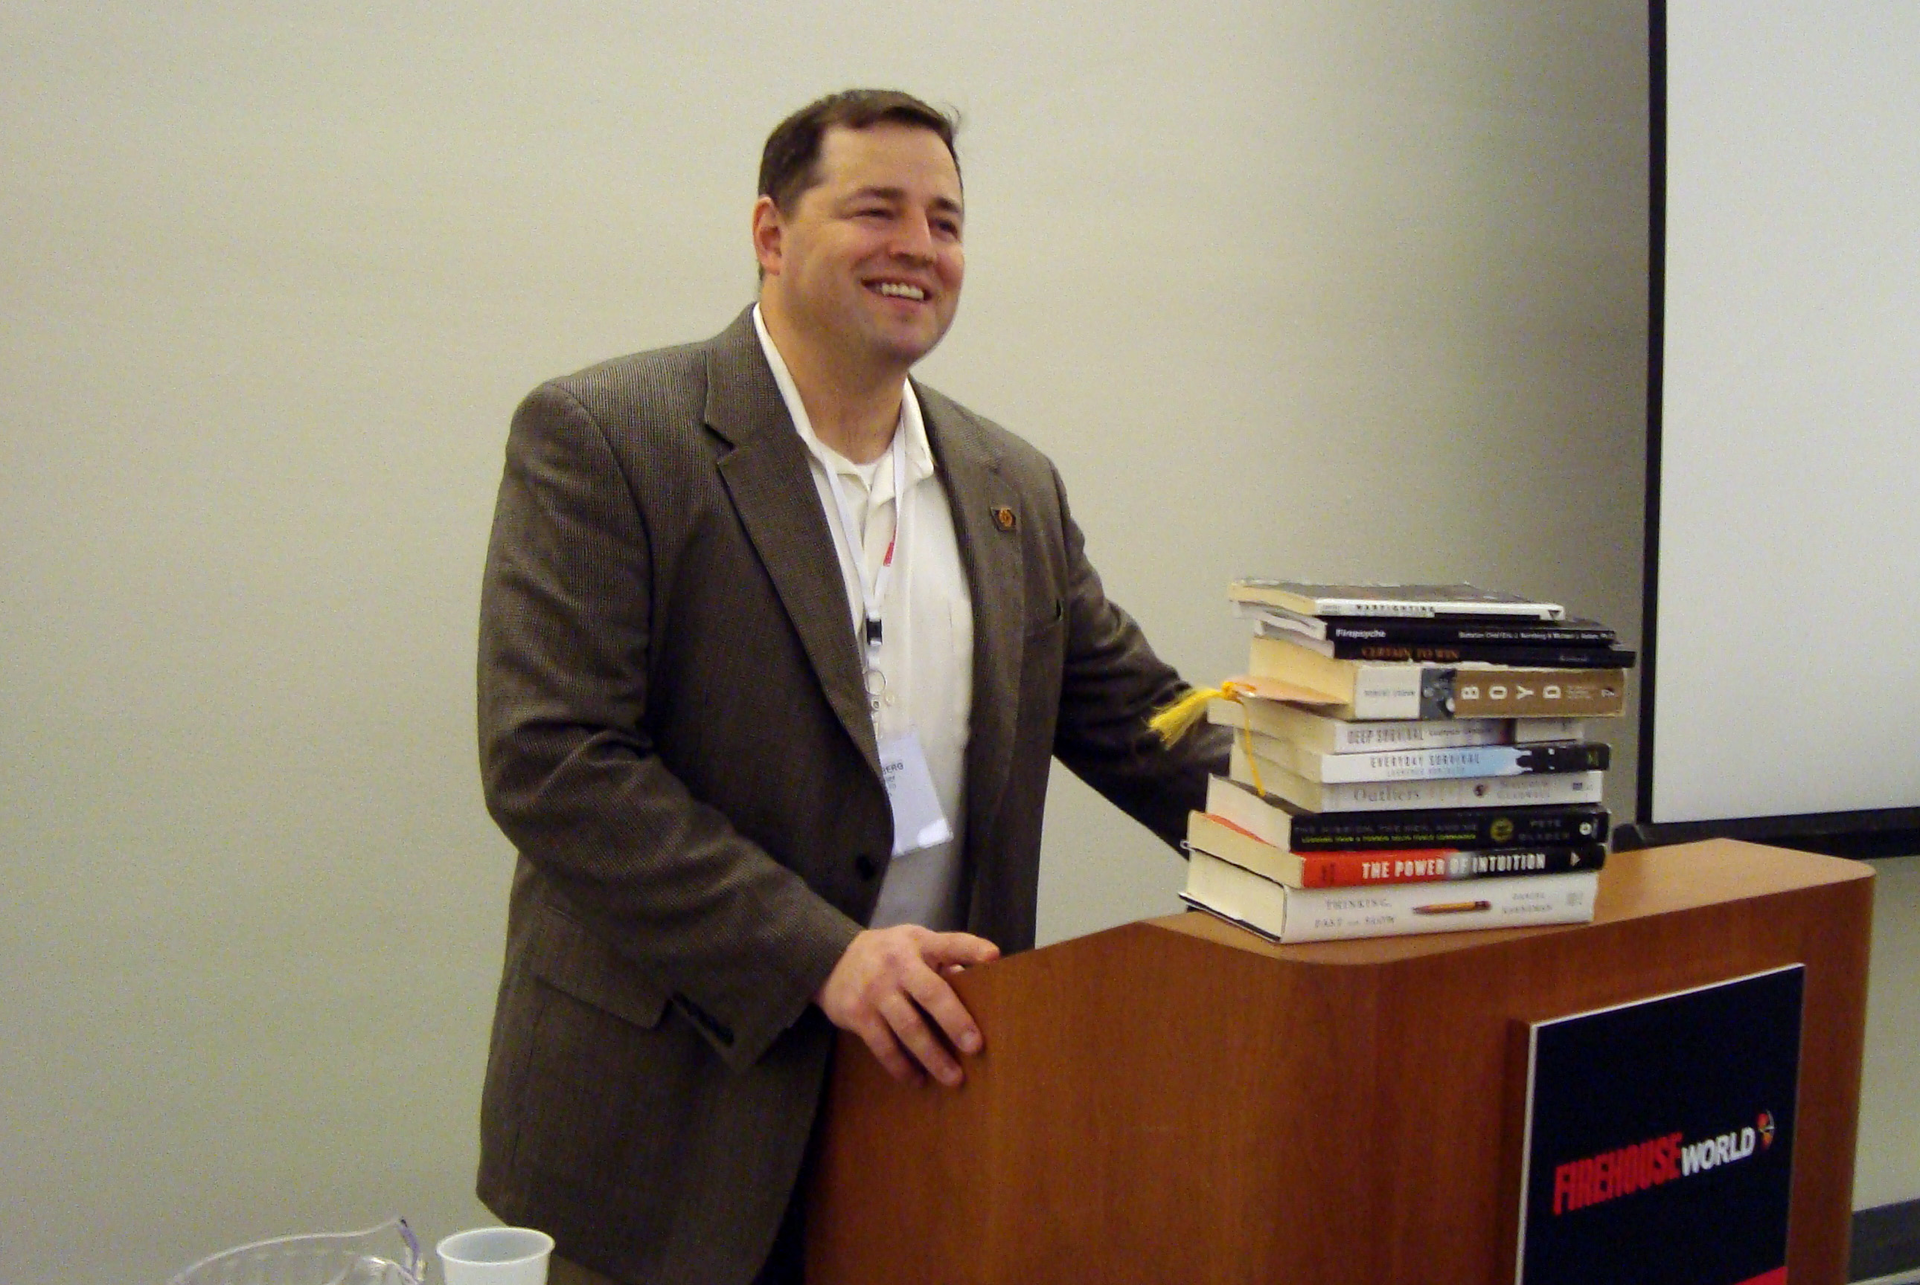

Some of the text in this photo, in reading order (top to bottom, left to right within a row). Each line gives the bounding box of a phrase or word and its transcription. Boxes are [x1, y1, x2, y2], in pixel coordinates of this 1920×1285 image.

[1335, 628, 1387, 640] Firepsyche
[1460, 684, 1562, 700] BOYD
[1369, 752, 1480, 769] EVERYDAY SURVIVAL
[1361, 853, 1547, 879] THE POWER OF INTUITION
[1553, 1126, 1756, 1217] FIREHOUSE WORLD
